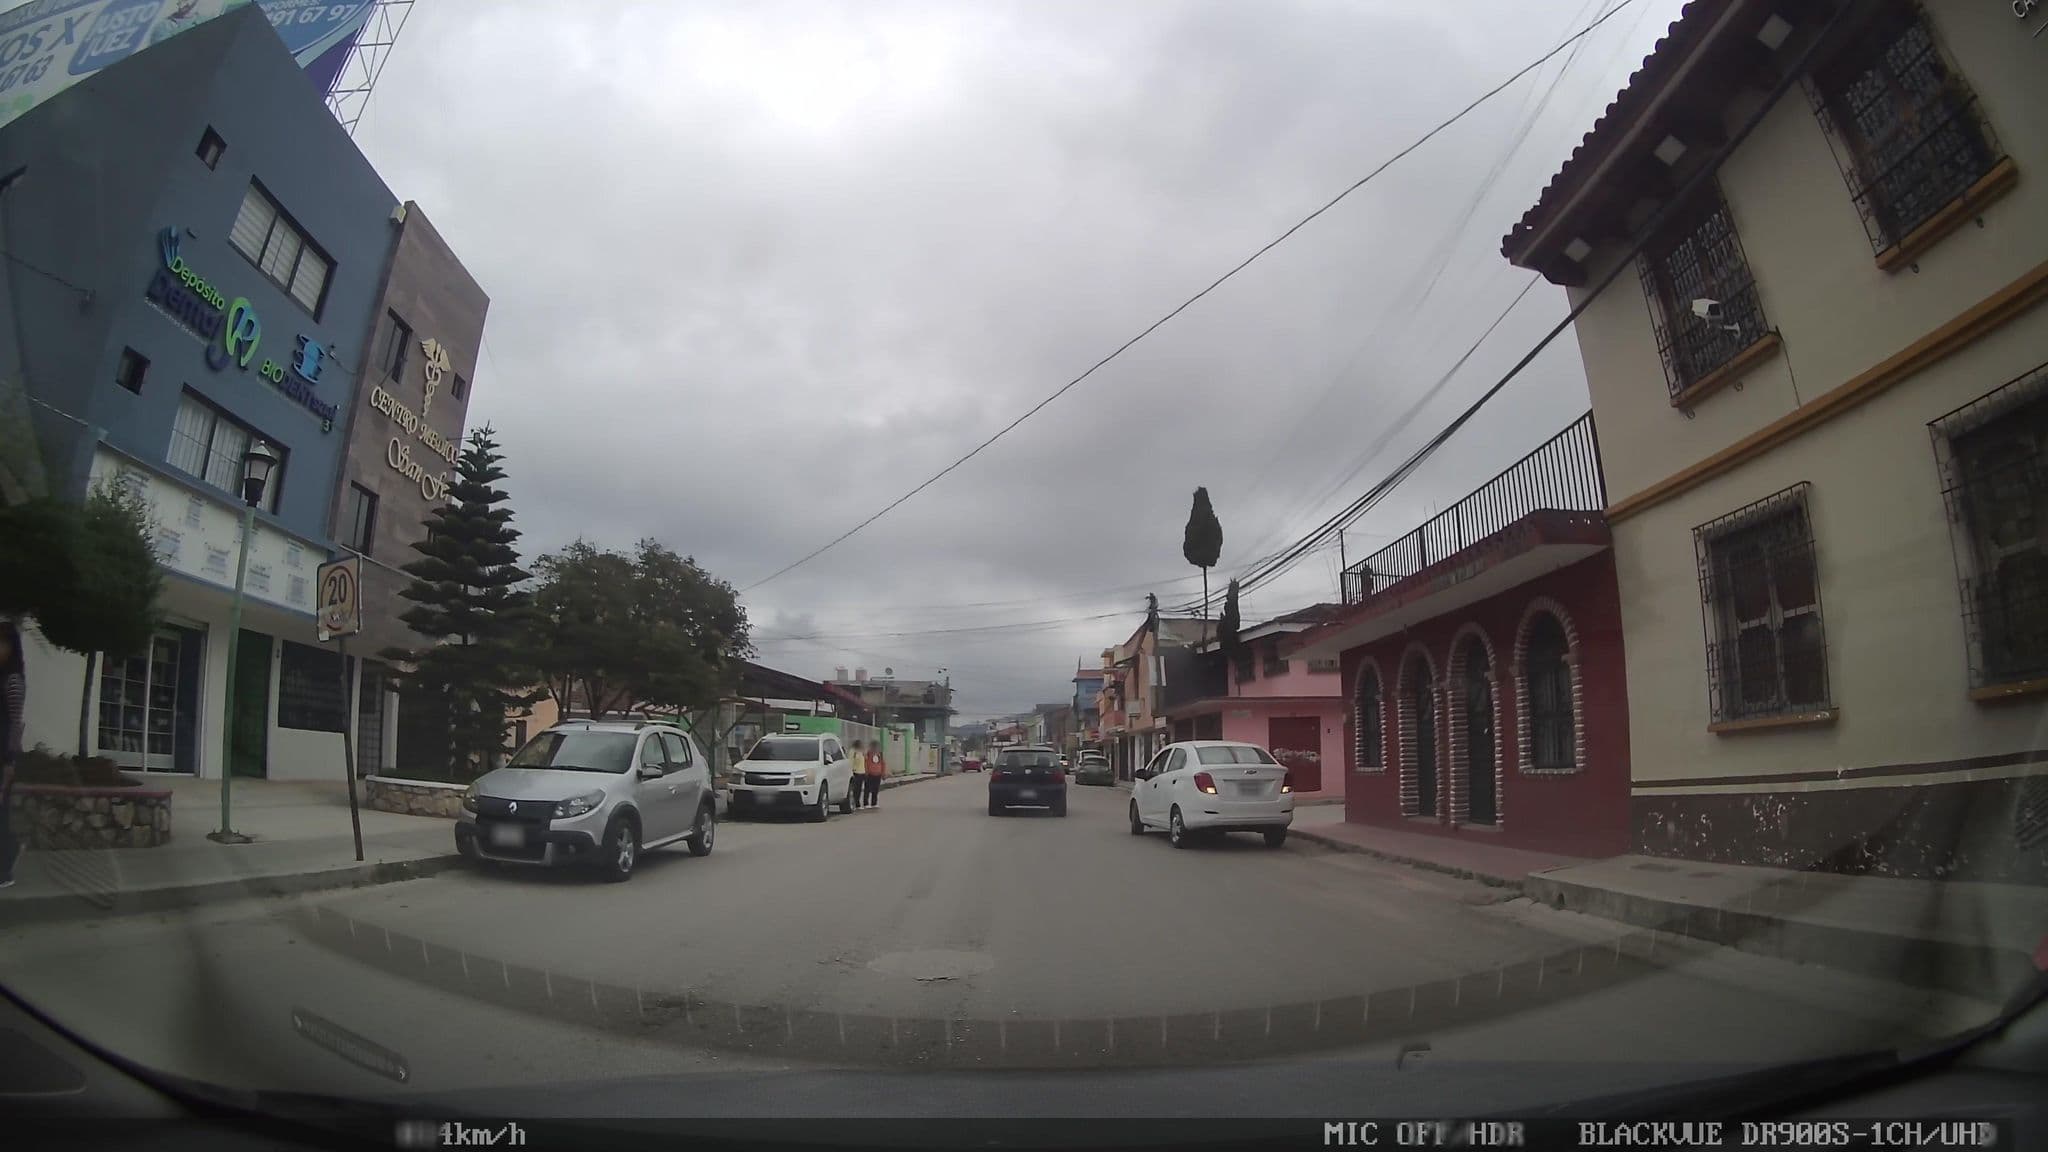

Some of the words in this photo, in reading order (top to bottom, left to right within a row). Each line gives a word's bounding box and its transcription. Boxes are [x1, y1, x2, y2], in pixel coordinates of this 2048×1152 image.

[299, 6, 328, 24] 67
[328, 4, 359, 21] 97
[0, 24, 53, 68] OS
[370, 386, 418, 435] CENTRO
[388, 437, 423, 483] San
[328, 573, 348, 606] 20
